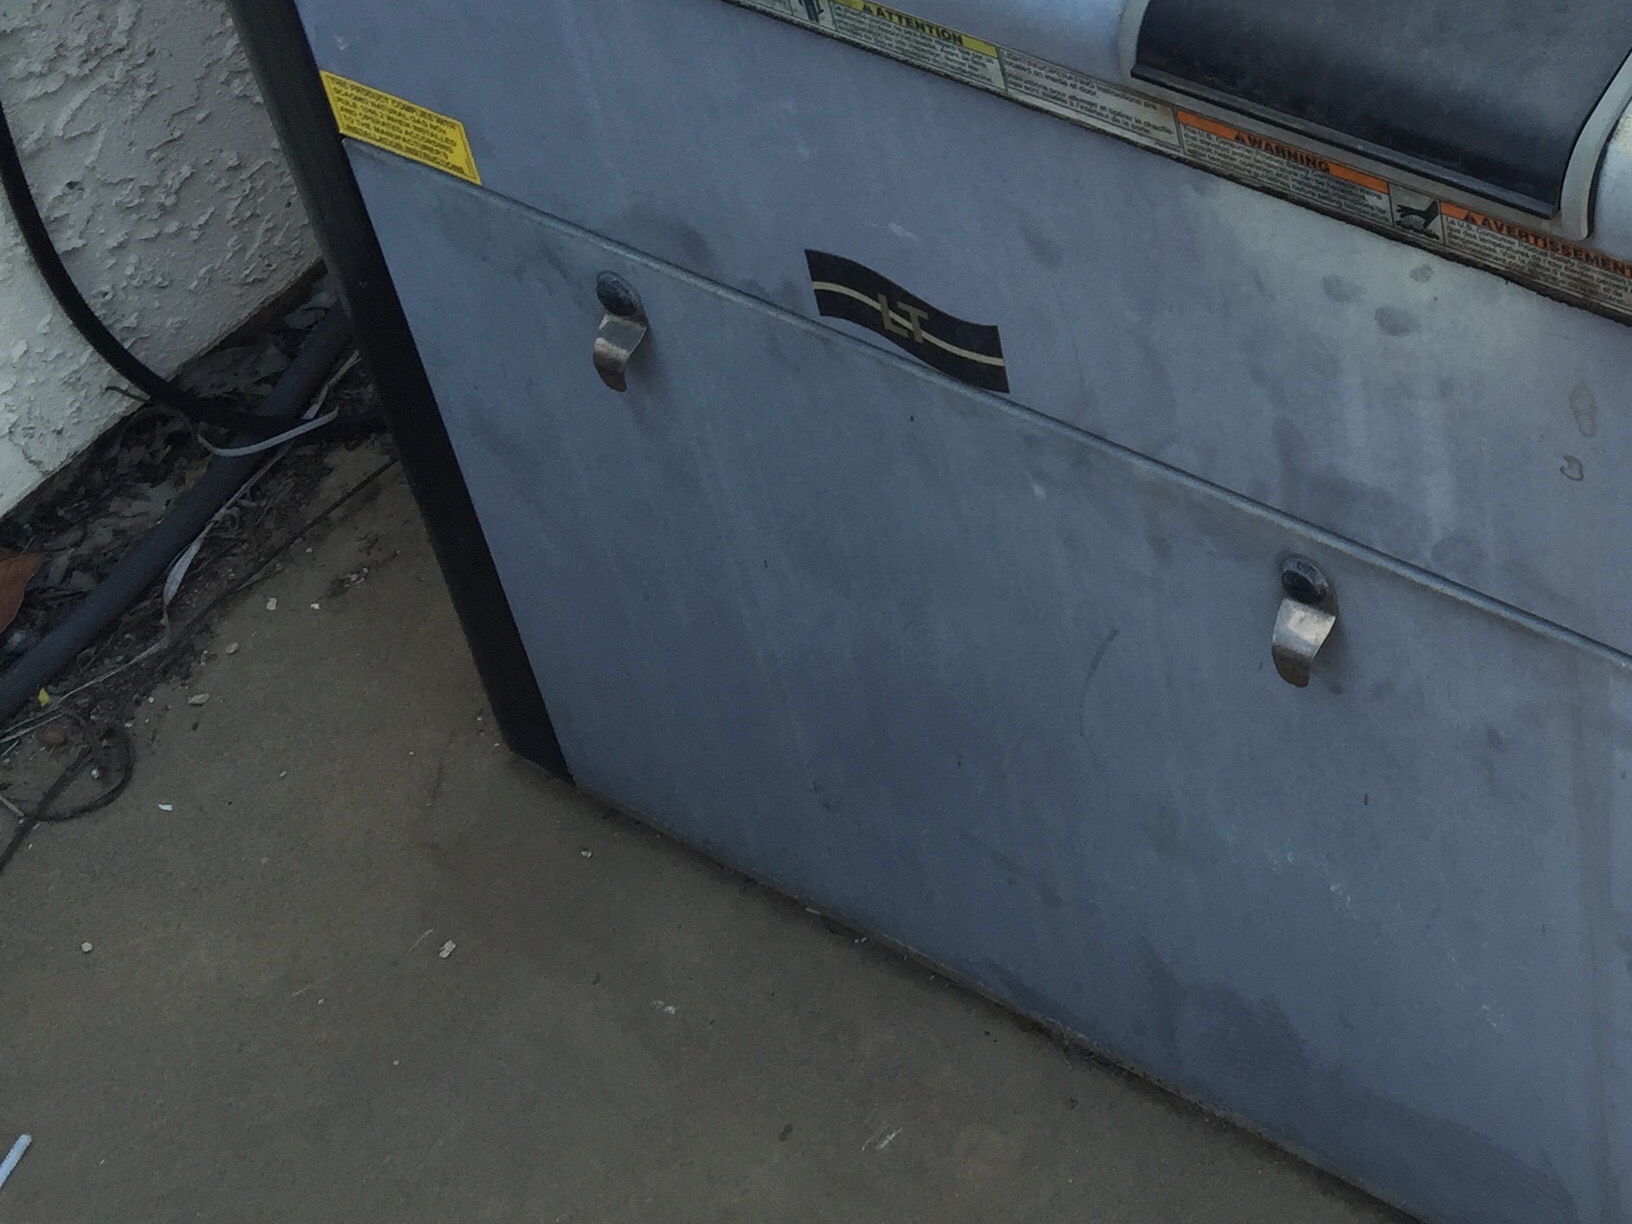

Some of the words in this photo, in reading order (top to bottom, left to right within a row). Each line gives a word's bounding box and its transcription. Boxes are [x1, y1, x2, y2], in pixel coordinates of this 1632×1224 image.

[874, 5, 964, 46] ATTENTION
[1245, 133, 1331, 174] WARNING
[877, 293, 929, 344] LT
